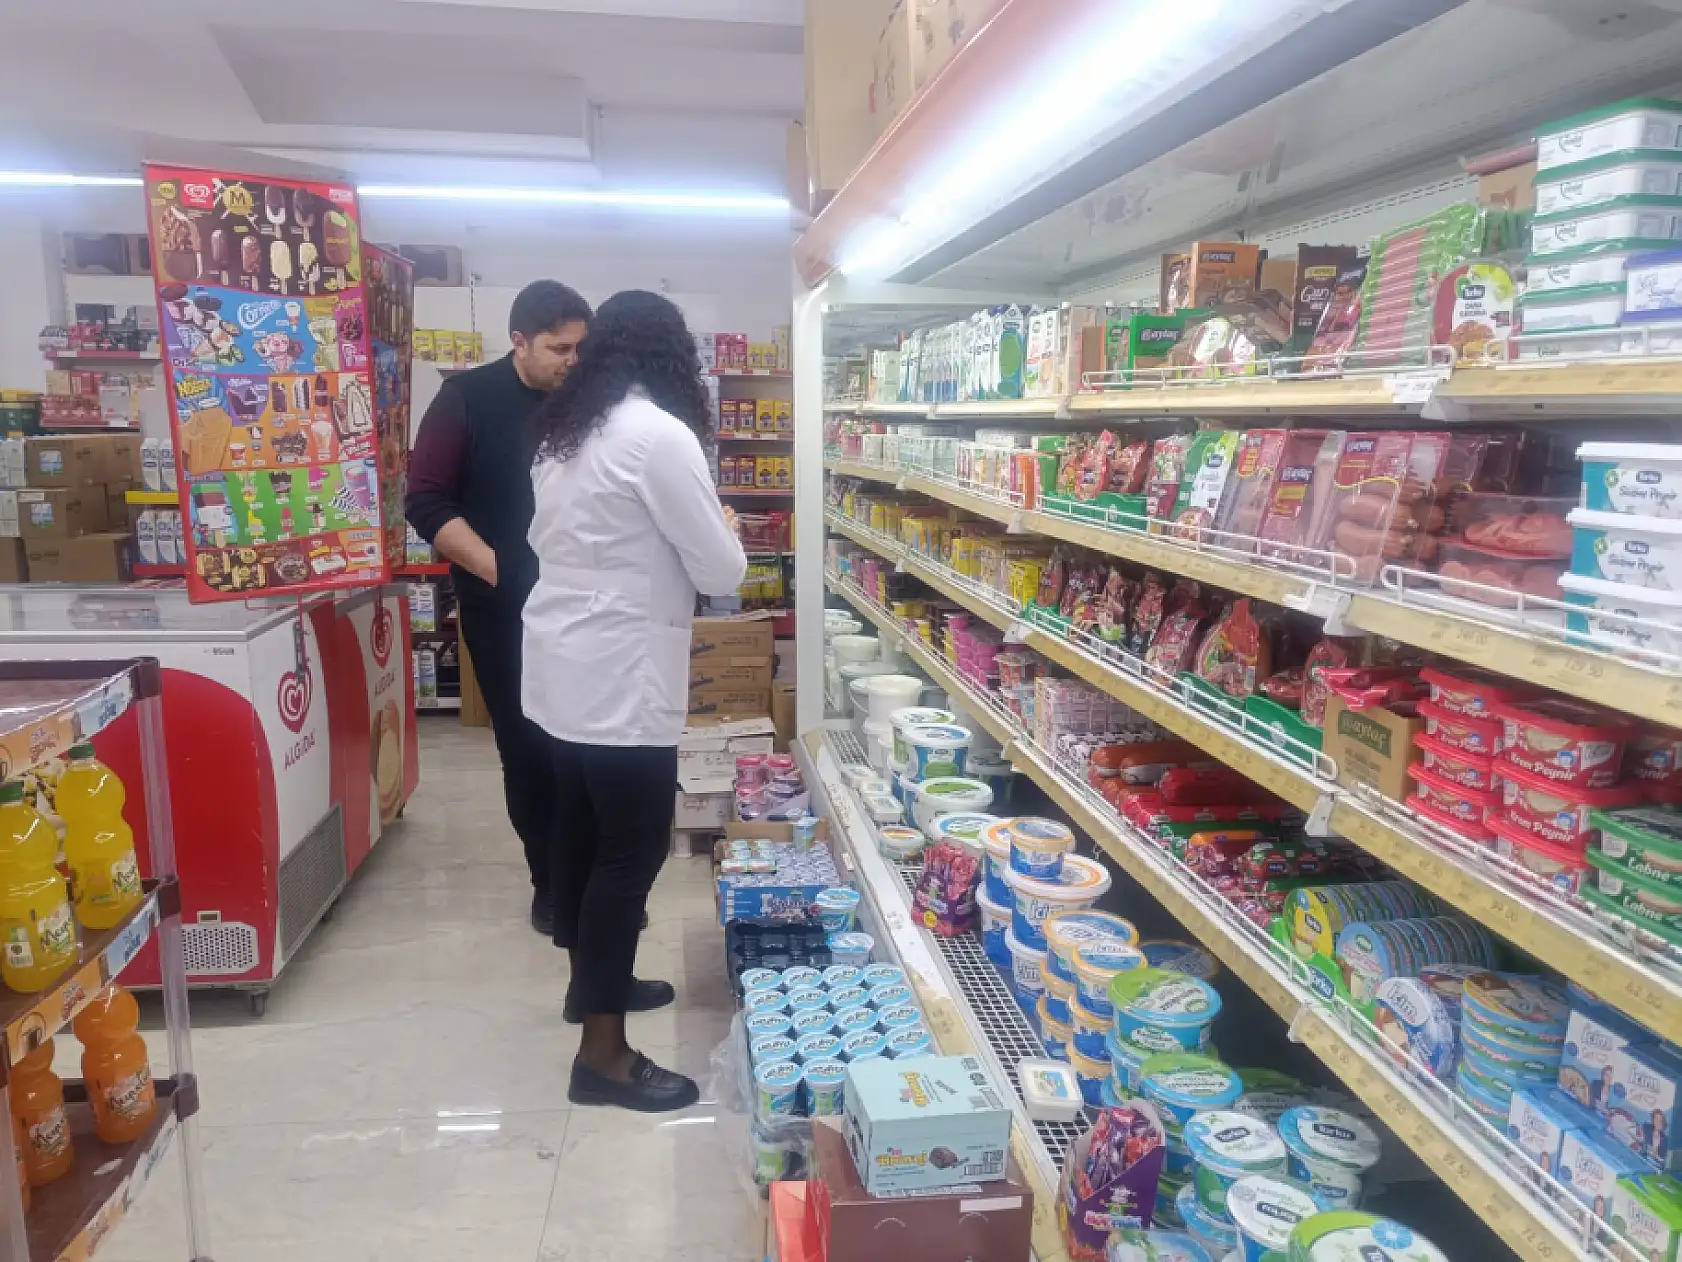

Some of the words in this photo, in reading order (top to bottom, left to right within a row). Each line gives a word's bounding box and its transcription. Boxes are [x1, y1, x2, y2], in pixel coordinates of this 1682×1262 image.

[284, 727, 315, 771] ALGIDA
[1534, 763, 1577, 781] Peynir
[1533, 822, 1576, 842] Peynir
